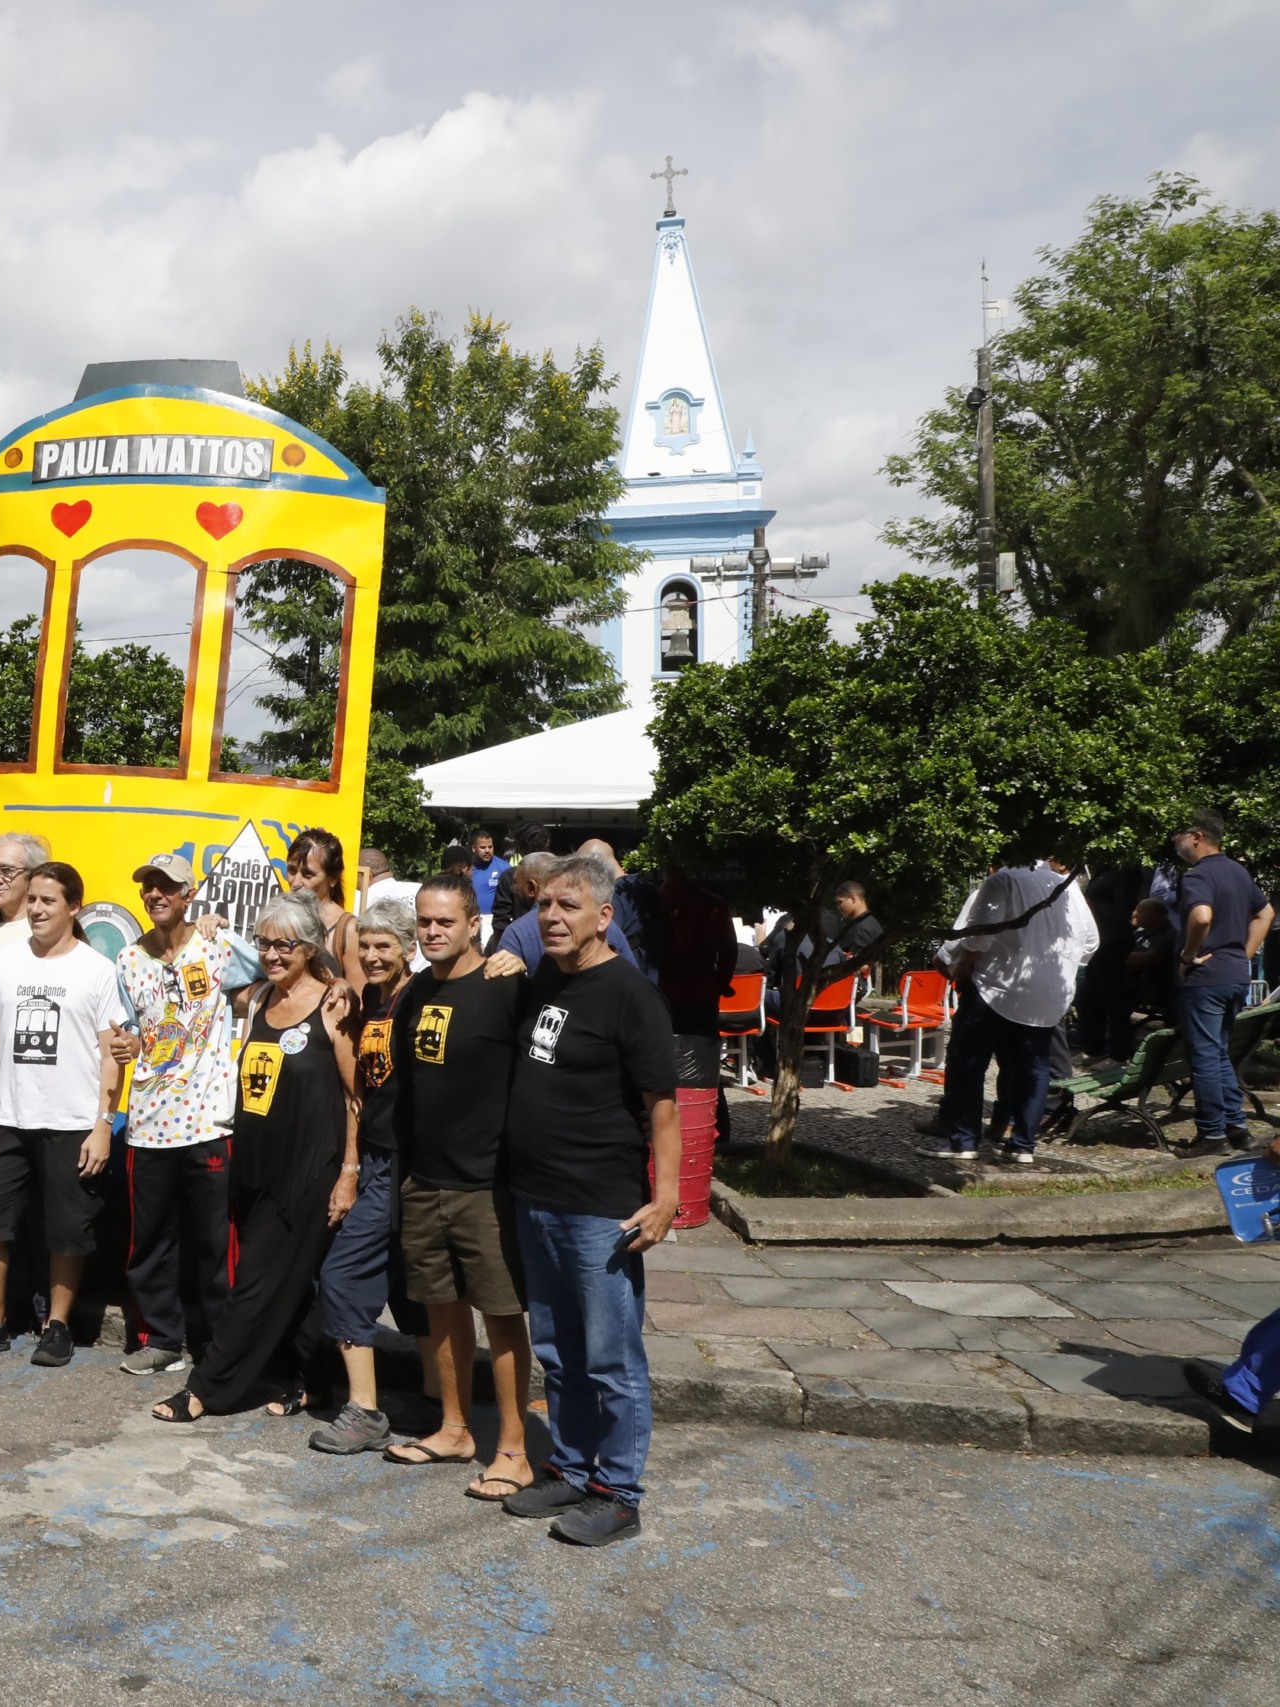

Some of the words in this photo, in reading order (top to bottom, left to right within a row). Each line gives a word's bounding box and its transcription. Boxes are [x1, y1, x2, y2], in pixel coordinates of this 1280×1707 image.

[40, 438, 129, 479] PAULA
[137, 437, 265, 478] MATTOS
[220, 857, 261, 880] Cadê
[16, 984, 36, 996] Cadê
[43, 985, 67, 997] Bonde
